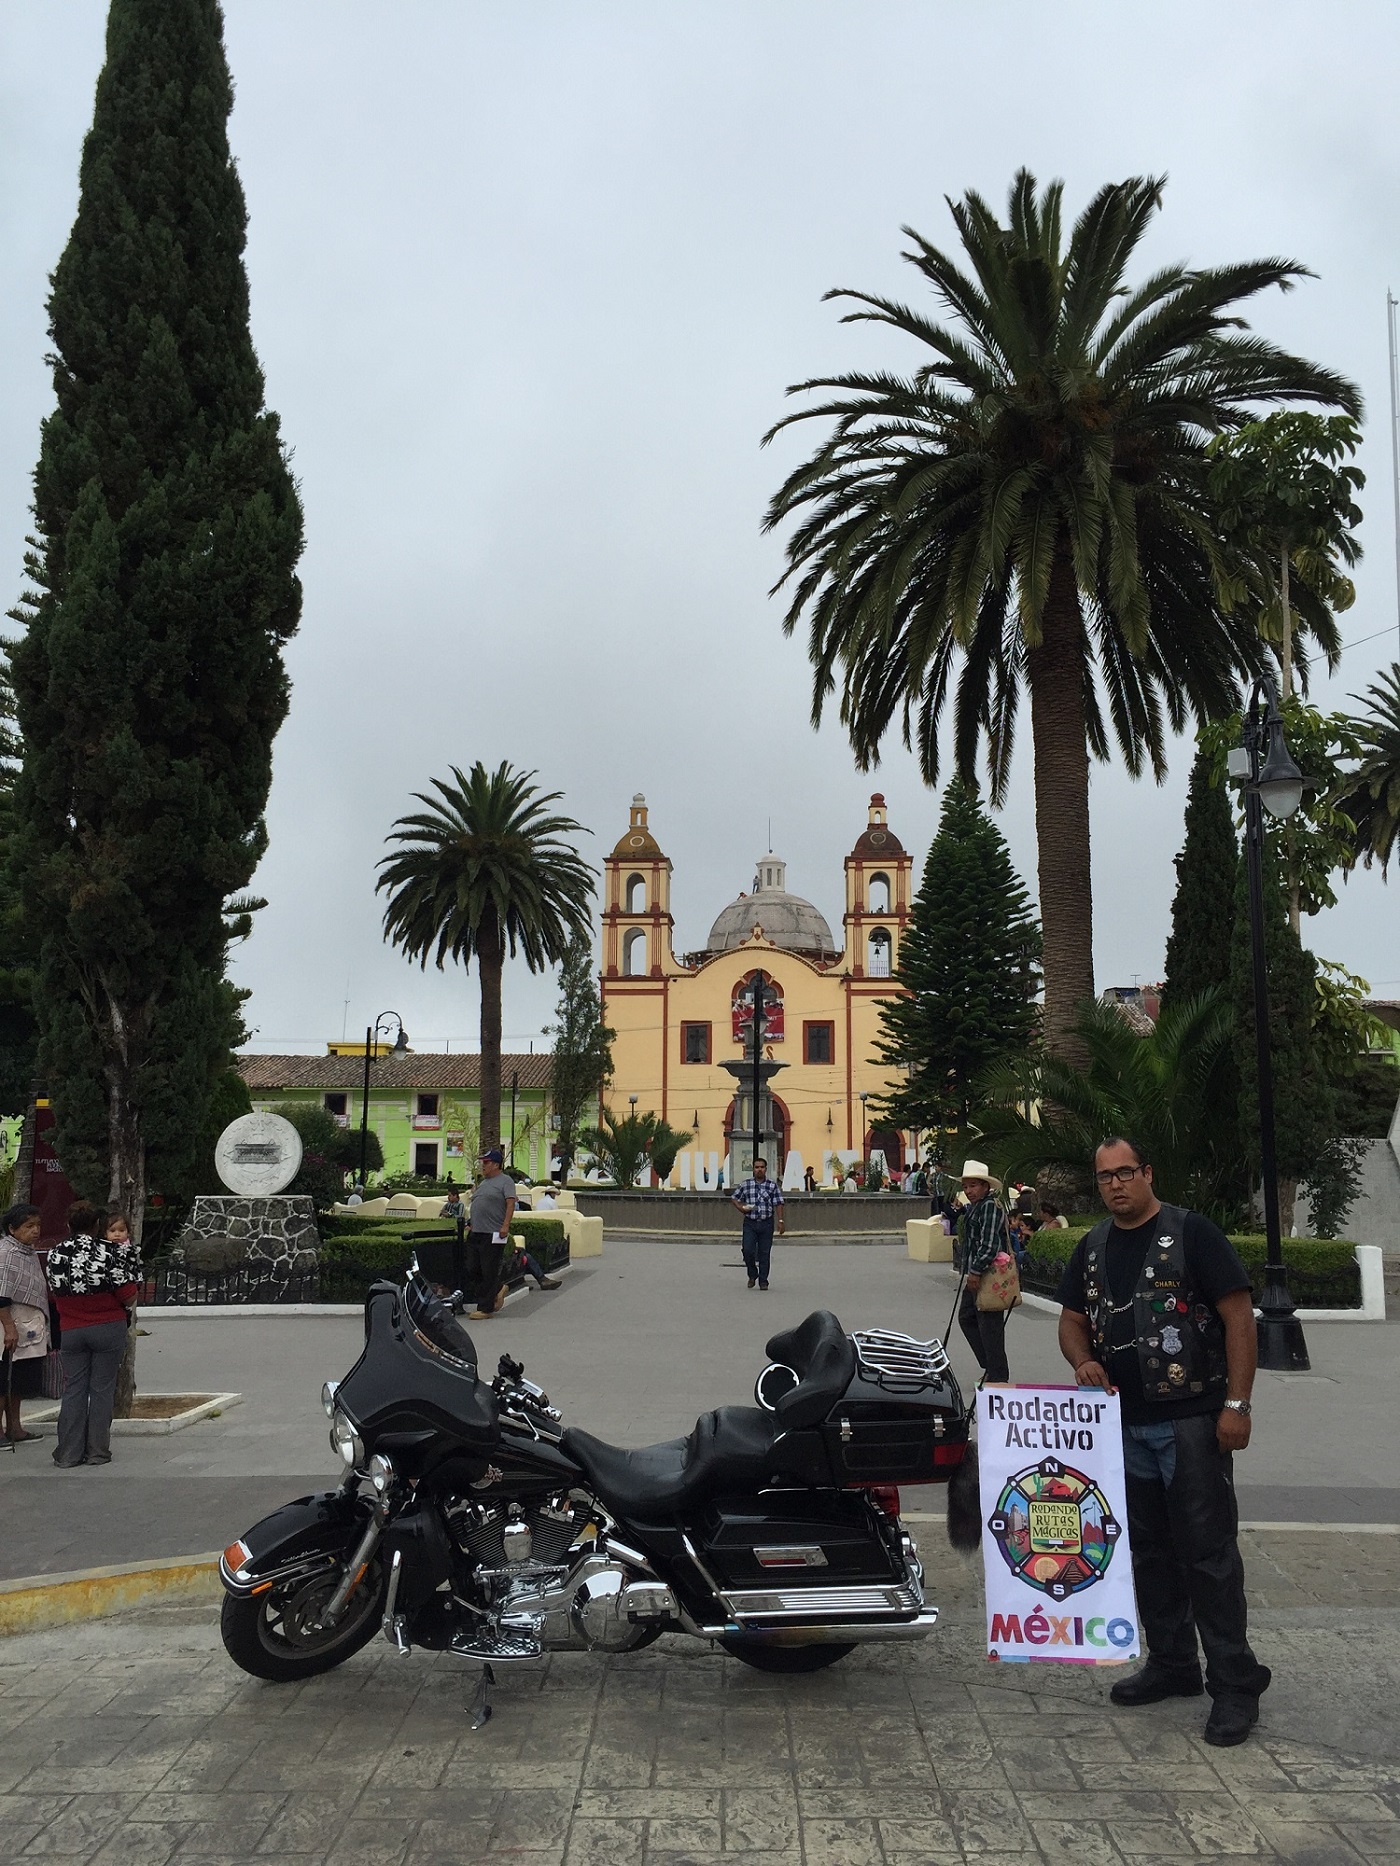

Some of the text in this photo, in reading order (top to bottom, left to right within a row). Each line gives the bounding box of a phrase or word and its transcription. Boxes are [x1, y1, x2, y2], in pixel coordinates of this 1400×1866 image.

[1154, 1280, 1181, 1288] CHARLY
[988, 1394, 1107, 1424] Rodador
[1005, 1422, 1094, 1451] Activo
[1045, 1462, 1059, 1473] N
[992, 1520, 1004, 1531] O
[1105, 1524, 1117, 1535] E
[1052, 1584, 1065, 1595] S
